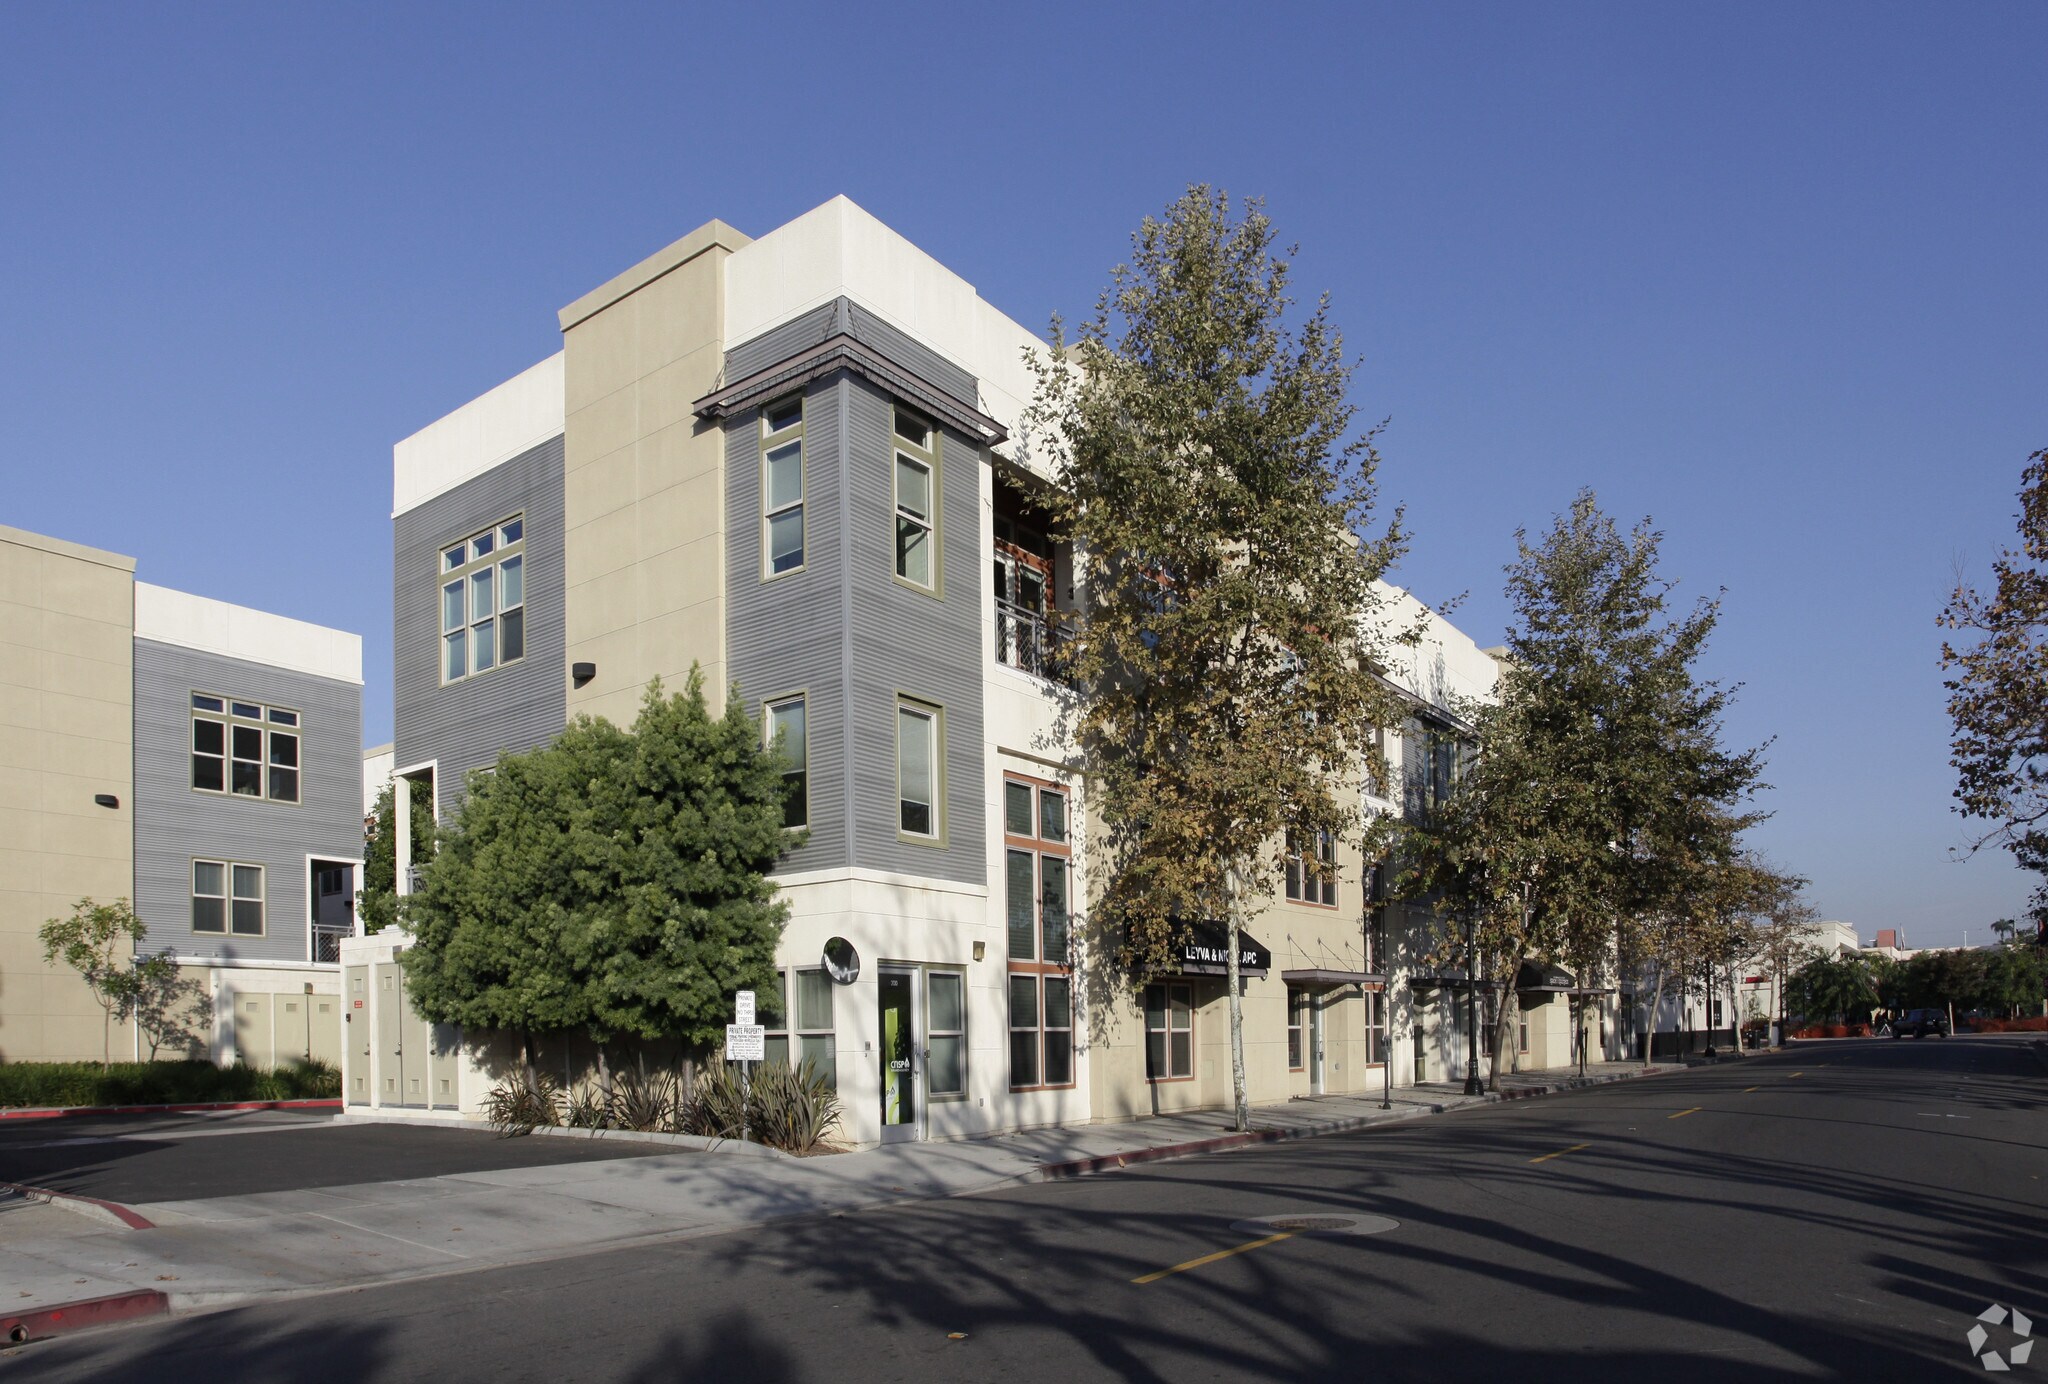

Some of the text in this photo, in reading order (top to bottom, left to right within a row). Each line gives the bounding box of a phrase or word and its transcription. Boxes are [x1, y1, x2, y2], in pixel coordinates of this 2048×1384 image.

[1185, 945, 1210, 960] LEYVA
[1211, 948, 1217, 962] &
[1242, 951, 1256, 964] APC
